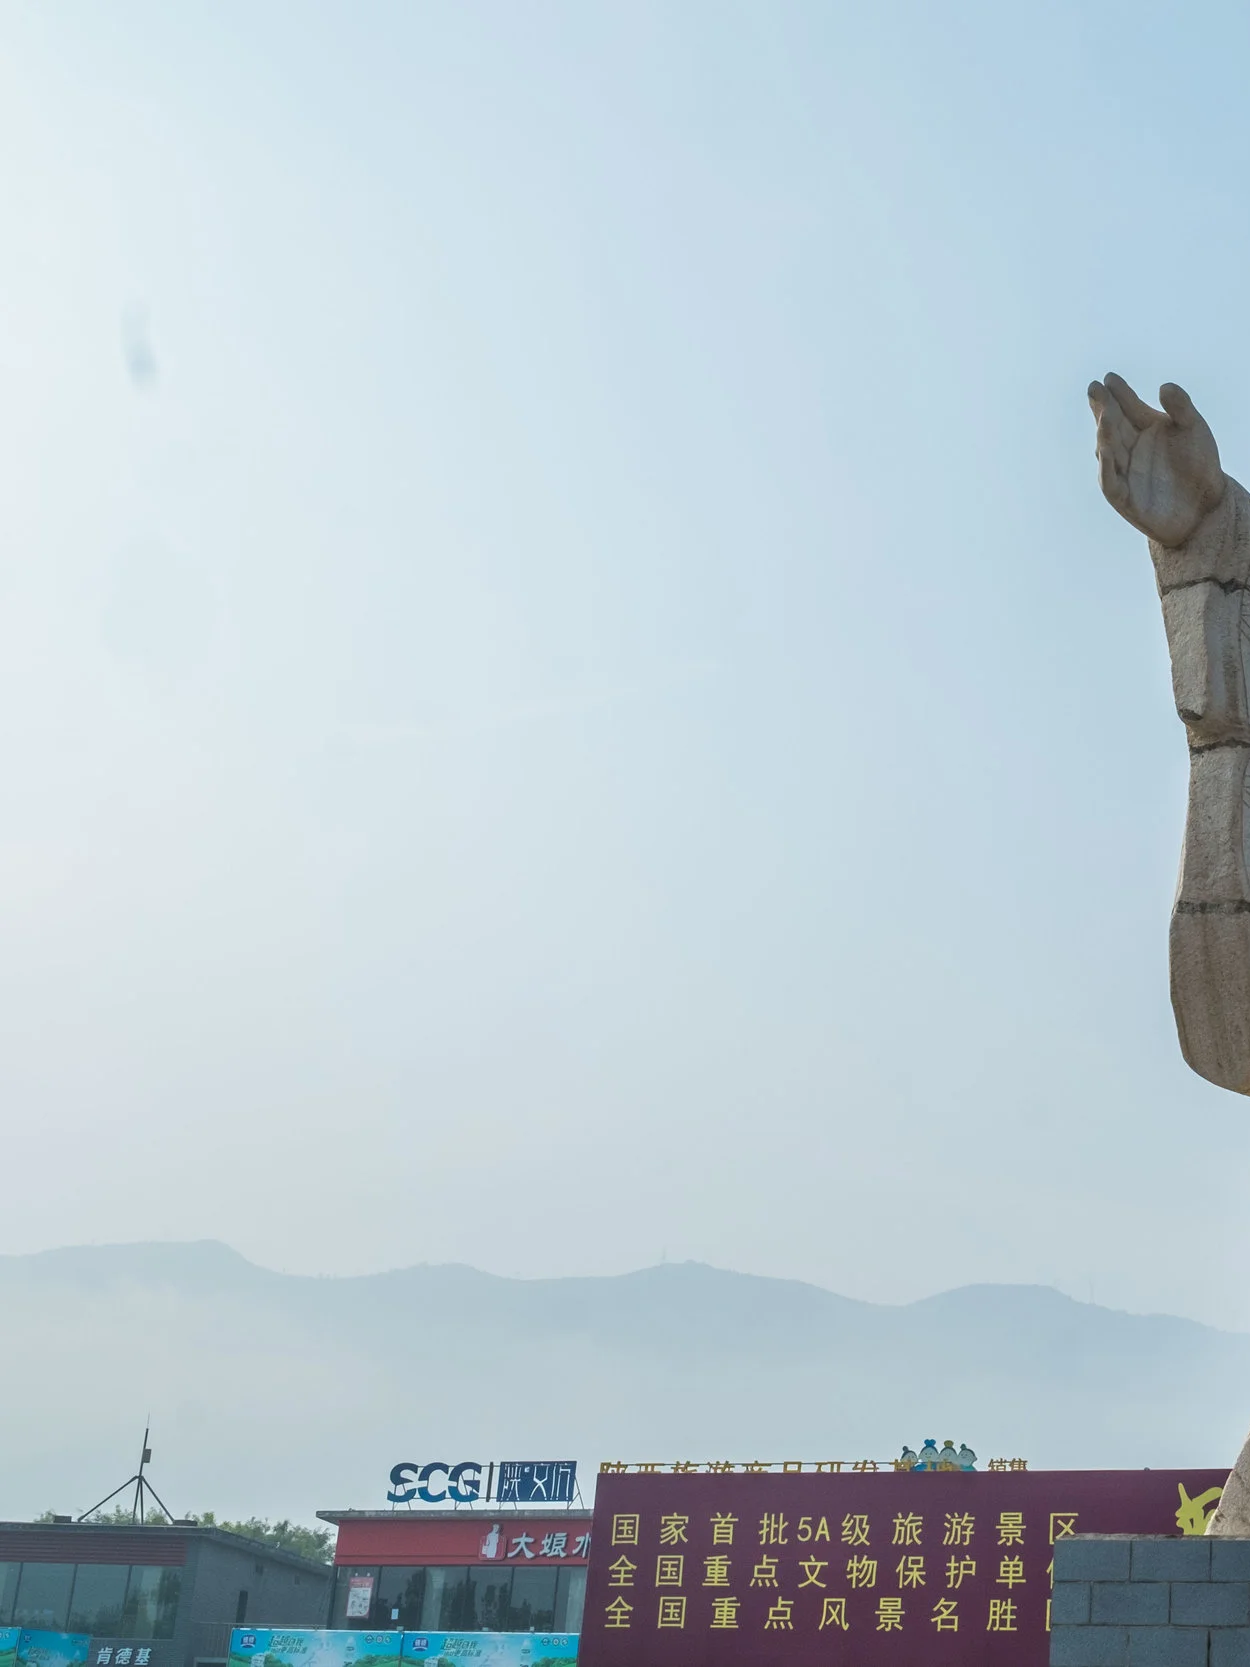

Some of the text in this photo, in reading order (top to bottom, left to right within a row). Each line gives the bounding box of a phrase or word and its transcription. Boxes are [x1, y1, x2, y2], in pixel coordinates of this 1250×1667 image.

[387, 1461, 482, 1502] SCG
[608, 1553, 1054, 1589] 全国重点文物保护单
[604, 1596, 1052, 1632] 全国重点风景名胜
[97, 1647, 151, 1665] 肯德基
